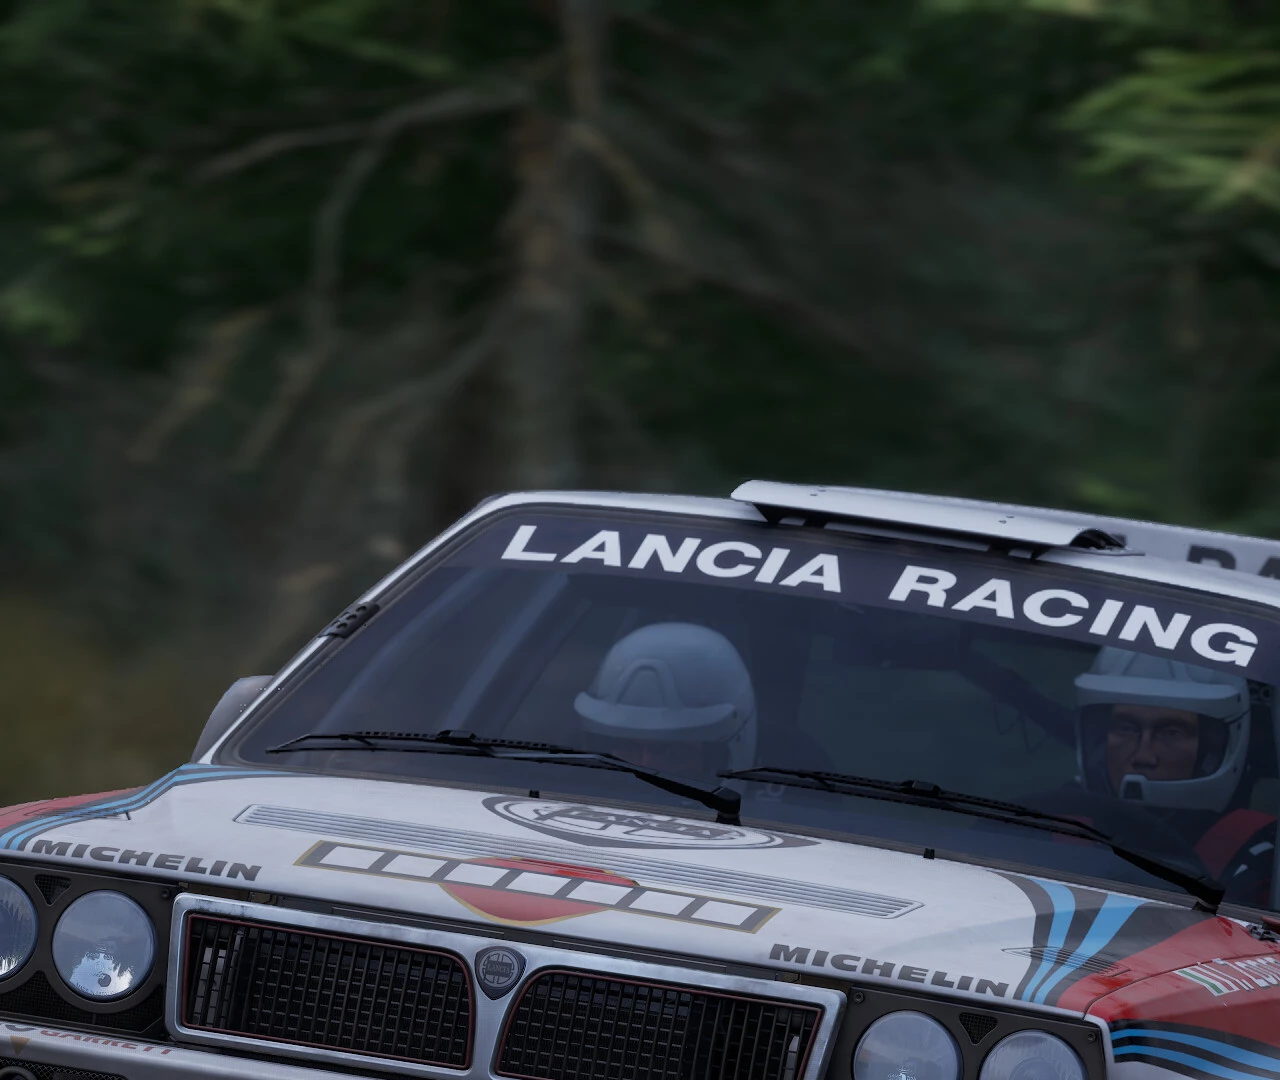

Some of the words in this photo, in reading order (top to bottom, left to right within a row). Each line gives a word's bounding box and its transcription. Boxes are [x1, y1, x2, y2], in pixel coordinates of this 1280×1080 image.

[501, 525, 843, 594] LANCIA
[887, 564, 1261, 668] RACING
[30, 839, 262, 881] MICHELIN
[769, 943, 1010, 999] MICHELIN
